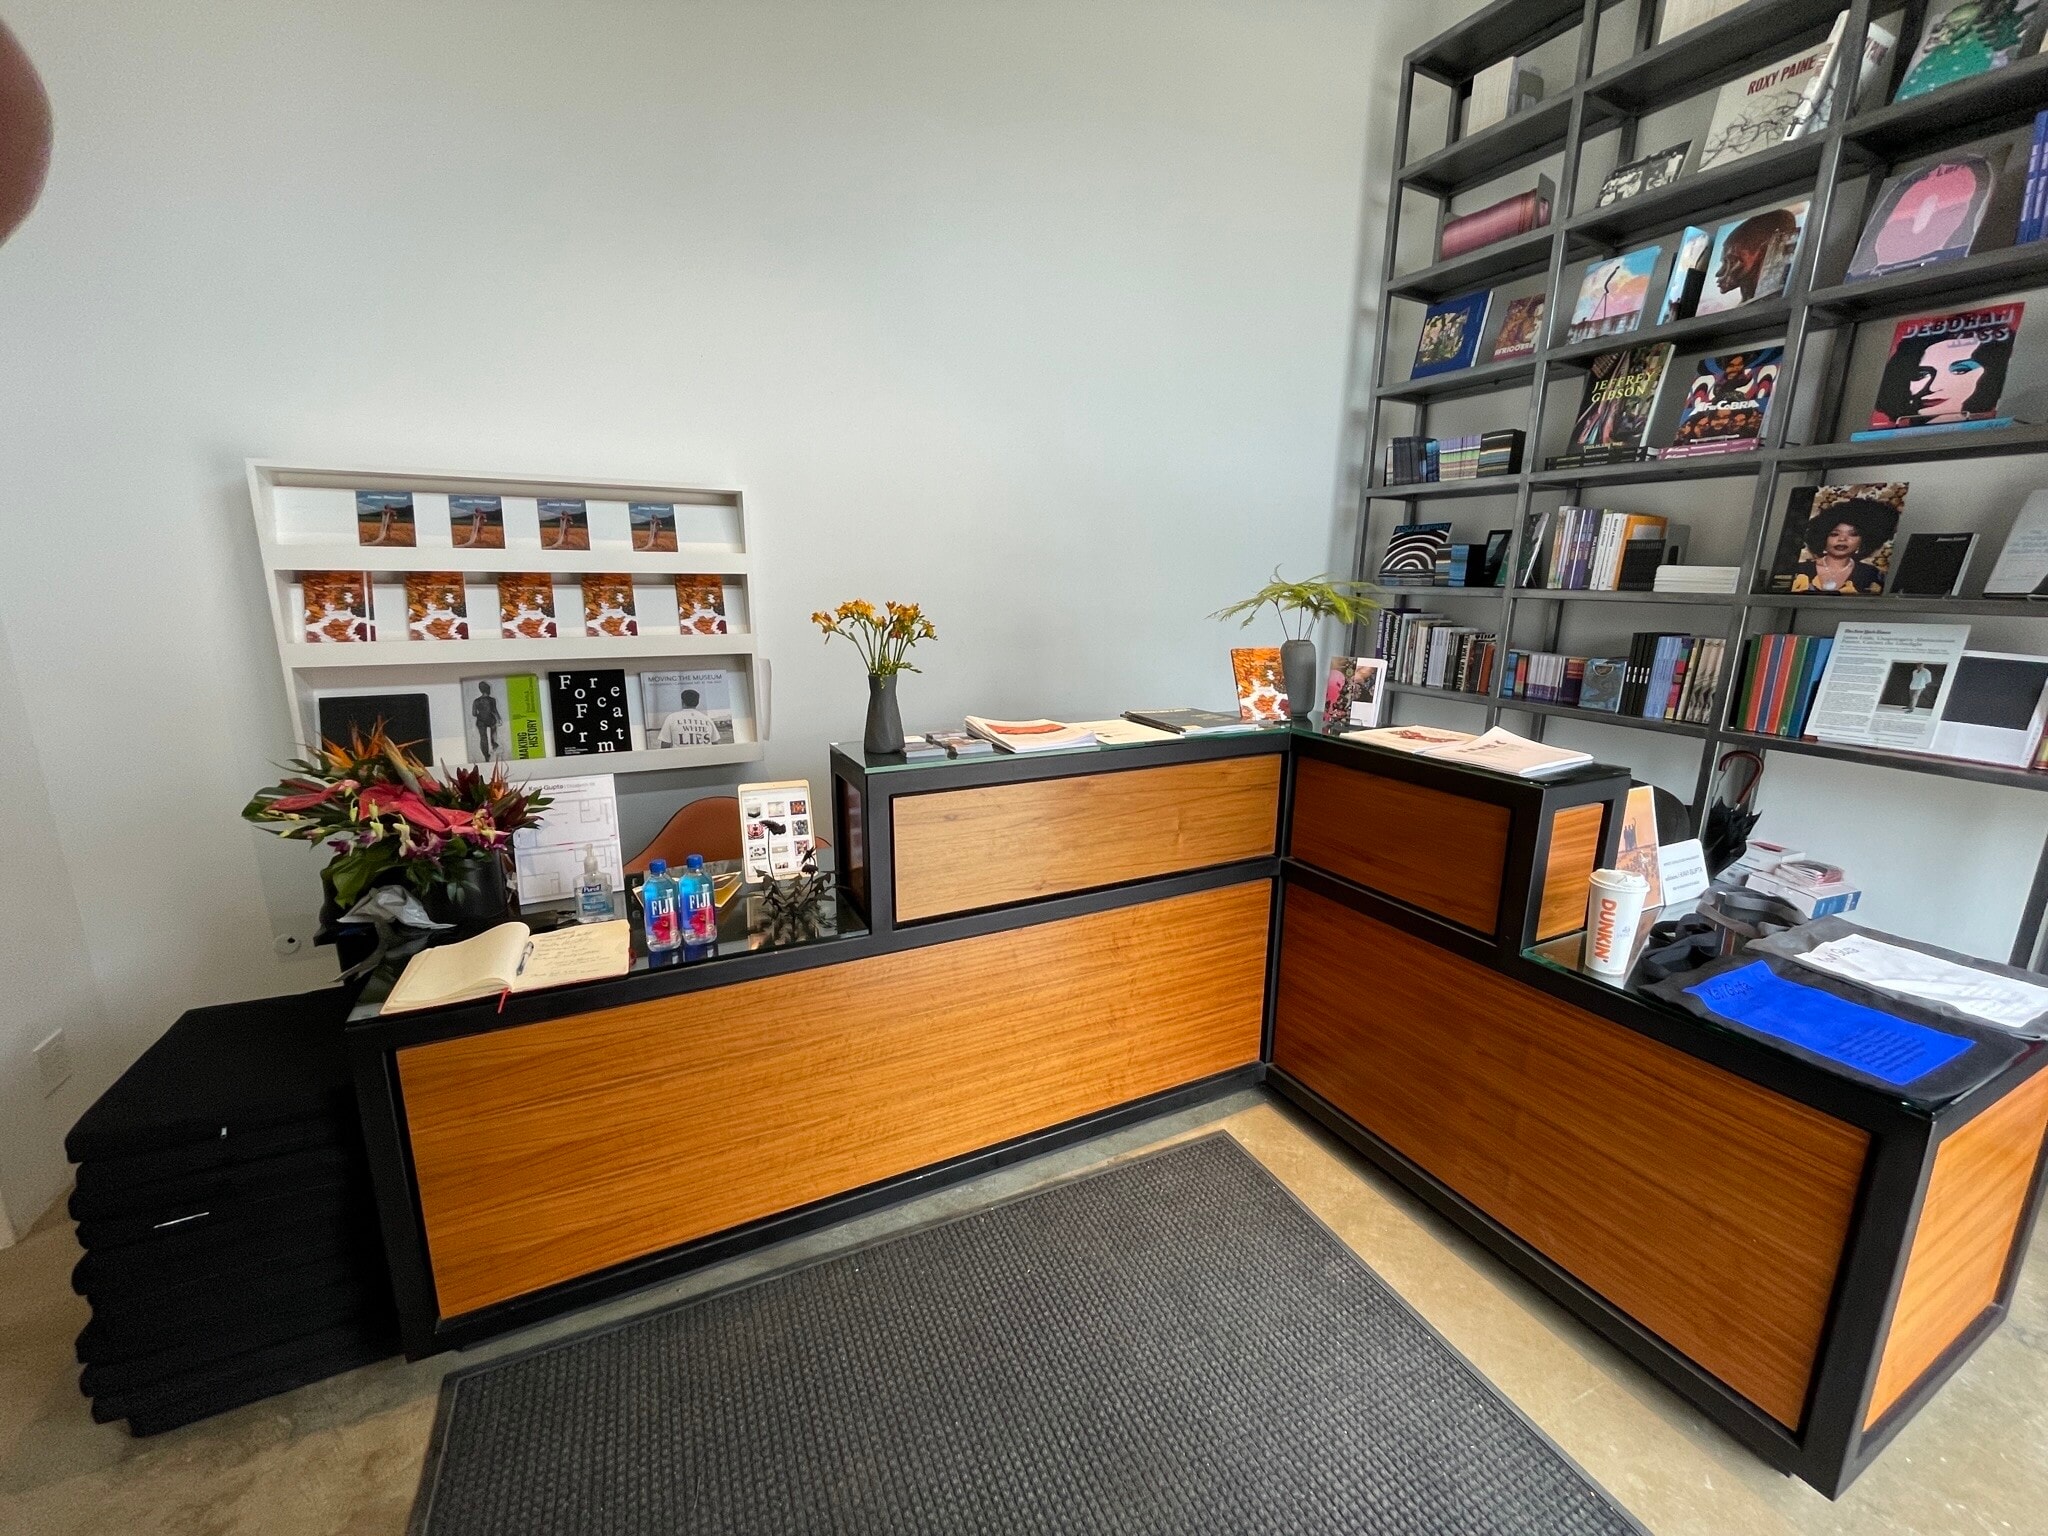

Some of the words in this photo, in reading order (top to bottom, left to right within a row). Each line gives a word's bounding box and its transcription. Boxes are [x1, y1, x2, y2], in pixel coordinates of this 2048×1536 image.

[1747, 71, 1779, 95] ROXY
[1780, 54, 1817, 82] PAINE
[1592, 372, 1655, 393] JEFFREY
[1591, 384, 1647, 403] GIBSON
[527, 719, 538, 748] HISTORY
[678, 733, 711, 744] LIES
[517, 732, 530, 759] MAKING
[651, 897, 675, 915] FIJI
[689, 892, 711, 909] FIJI
[1594, 898, 1617, 963] DUNKIN'
